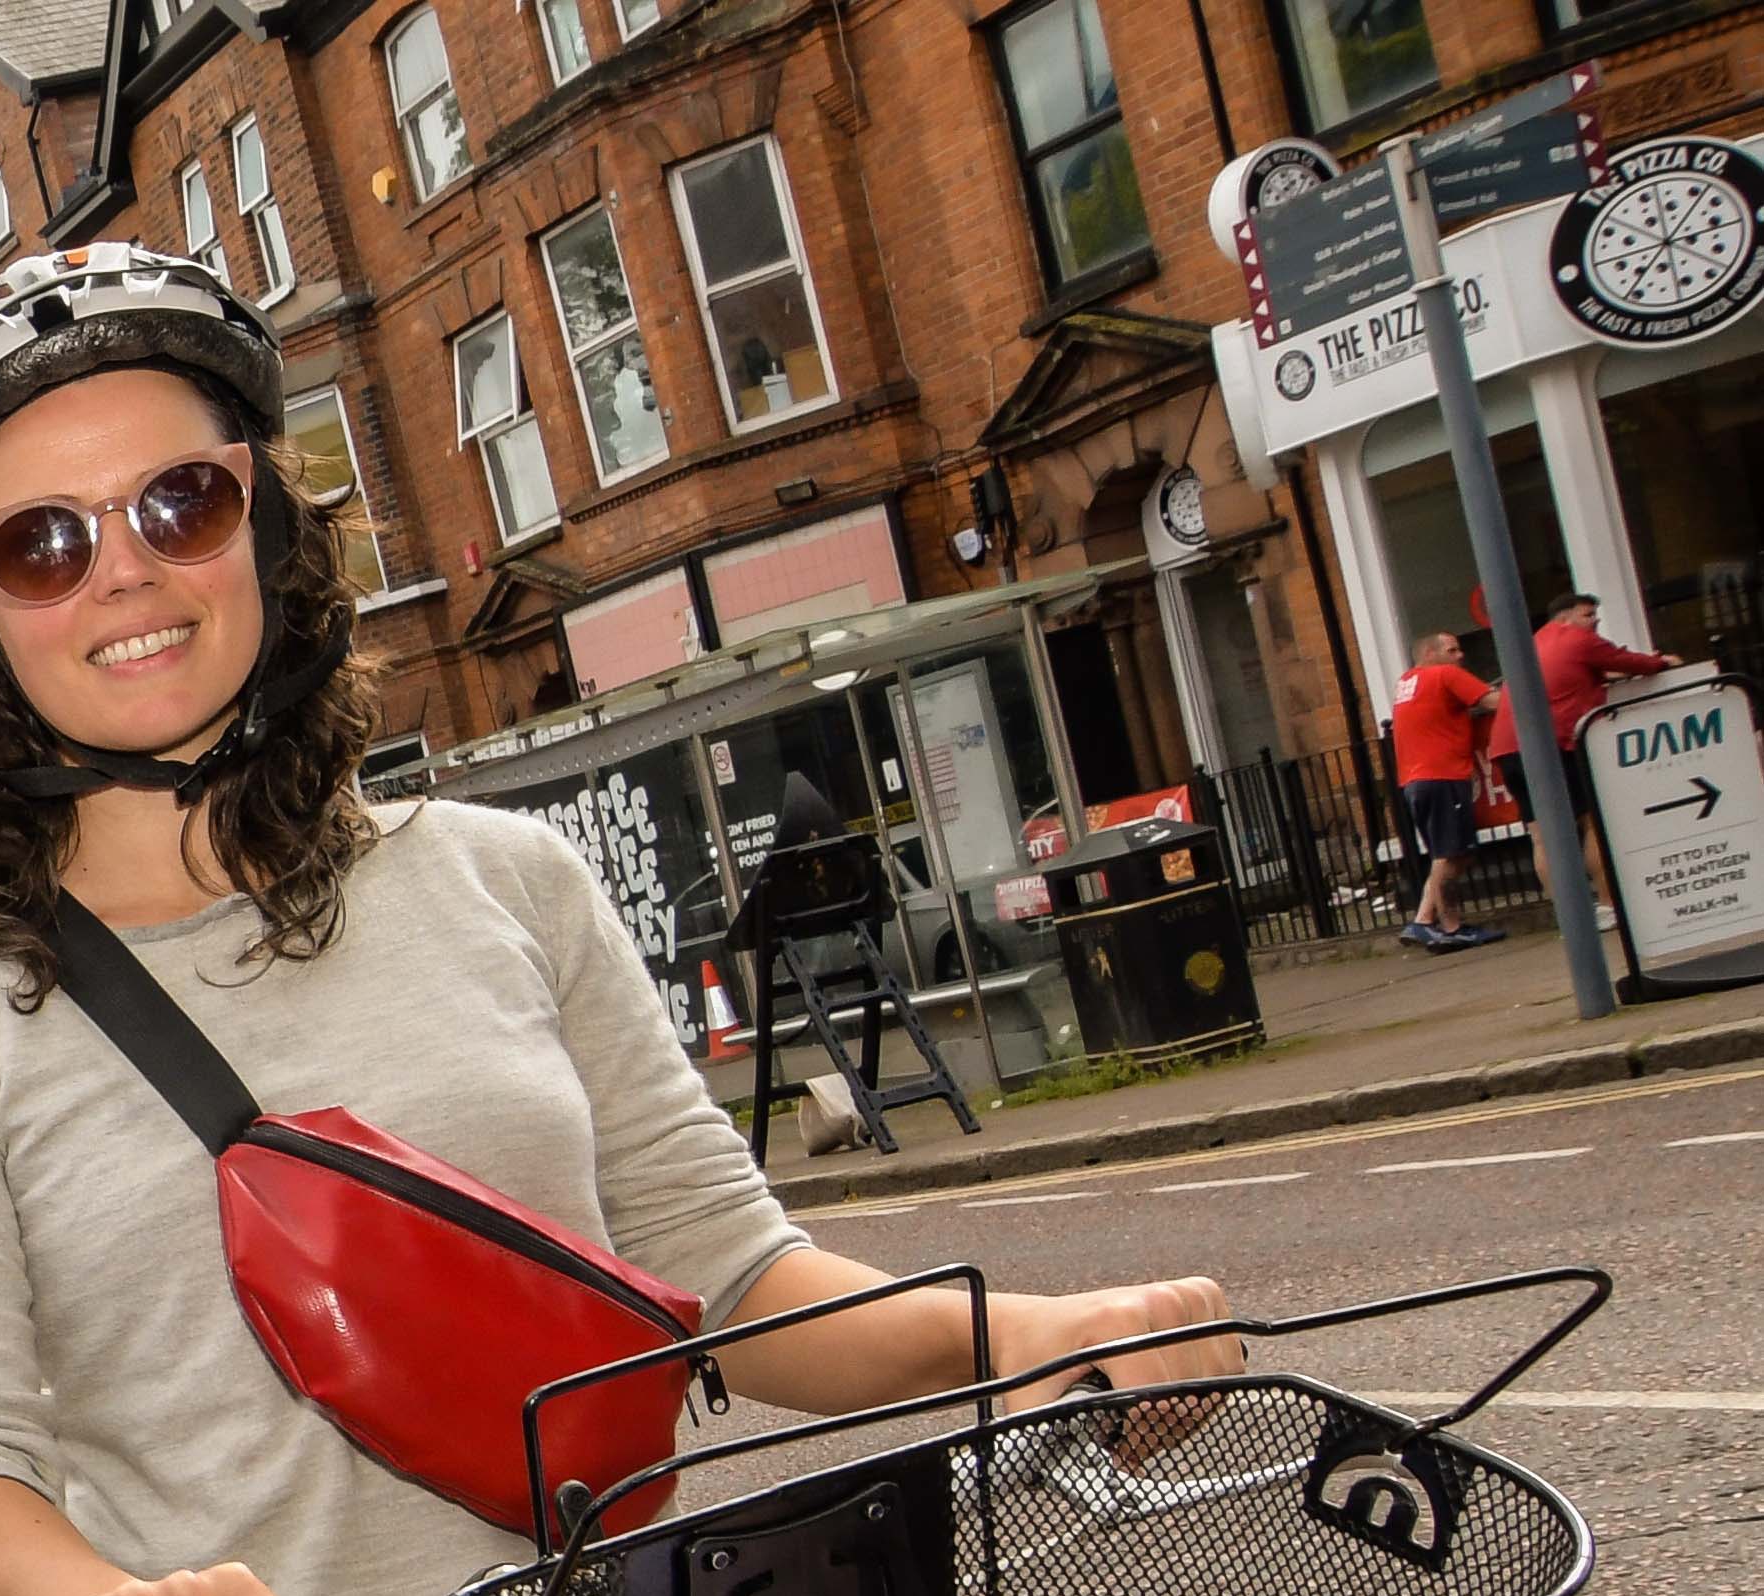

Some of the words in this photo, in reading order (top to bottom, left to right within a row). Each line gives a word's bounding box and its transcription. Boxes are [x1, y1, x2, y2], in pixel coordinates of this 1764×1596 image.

[1621, 146, 1688, 182] PIZZA
[1692, 147, 1730, 175] CO.
[1318, 324, 1365, 370] THE
[1368, 301, 1424, 351] PIZZ
[1450, 278, 1490, 320] O.
[1643, 316, 1690, 336] FRESH
[1616, 707, 1723, 769] DAM
[1645, 871, 1673, 887] PCR
[1675, 867, 1685, 880] &
[1687, 851, 1752, 878] ANTIGEN
[1659, 852, 1681, 868] FIT
[1682, 848, 1704, 863] TO
[1706, 841, 1730, 858] FLY
[1656, 884, 1689, 900] TEST
[1691, 868, 1747, 892] CENTRE
[1674, 893, 1739, 918] WALK-IN
